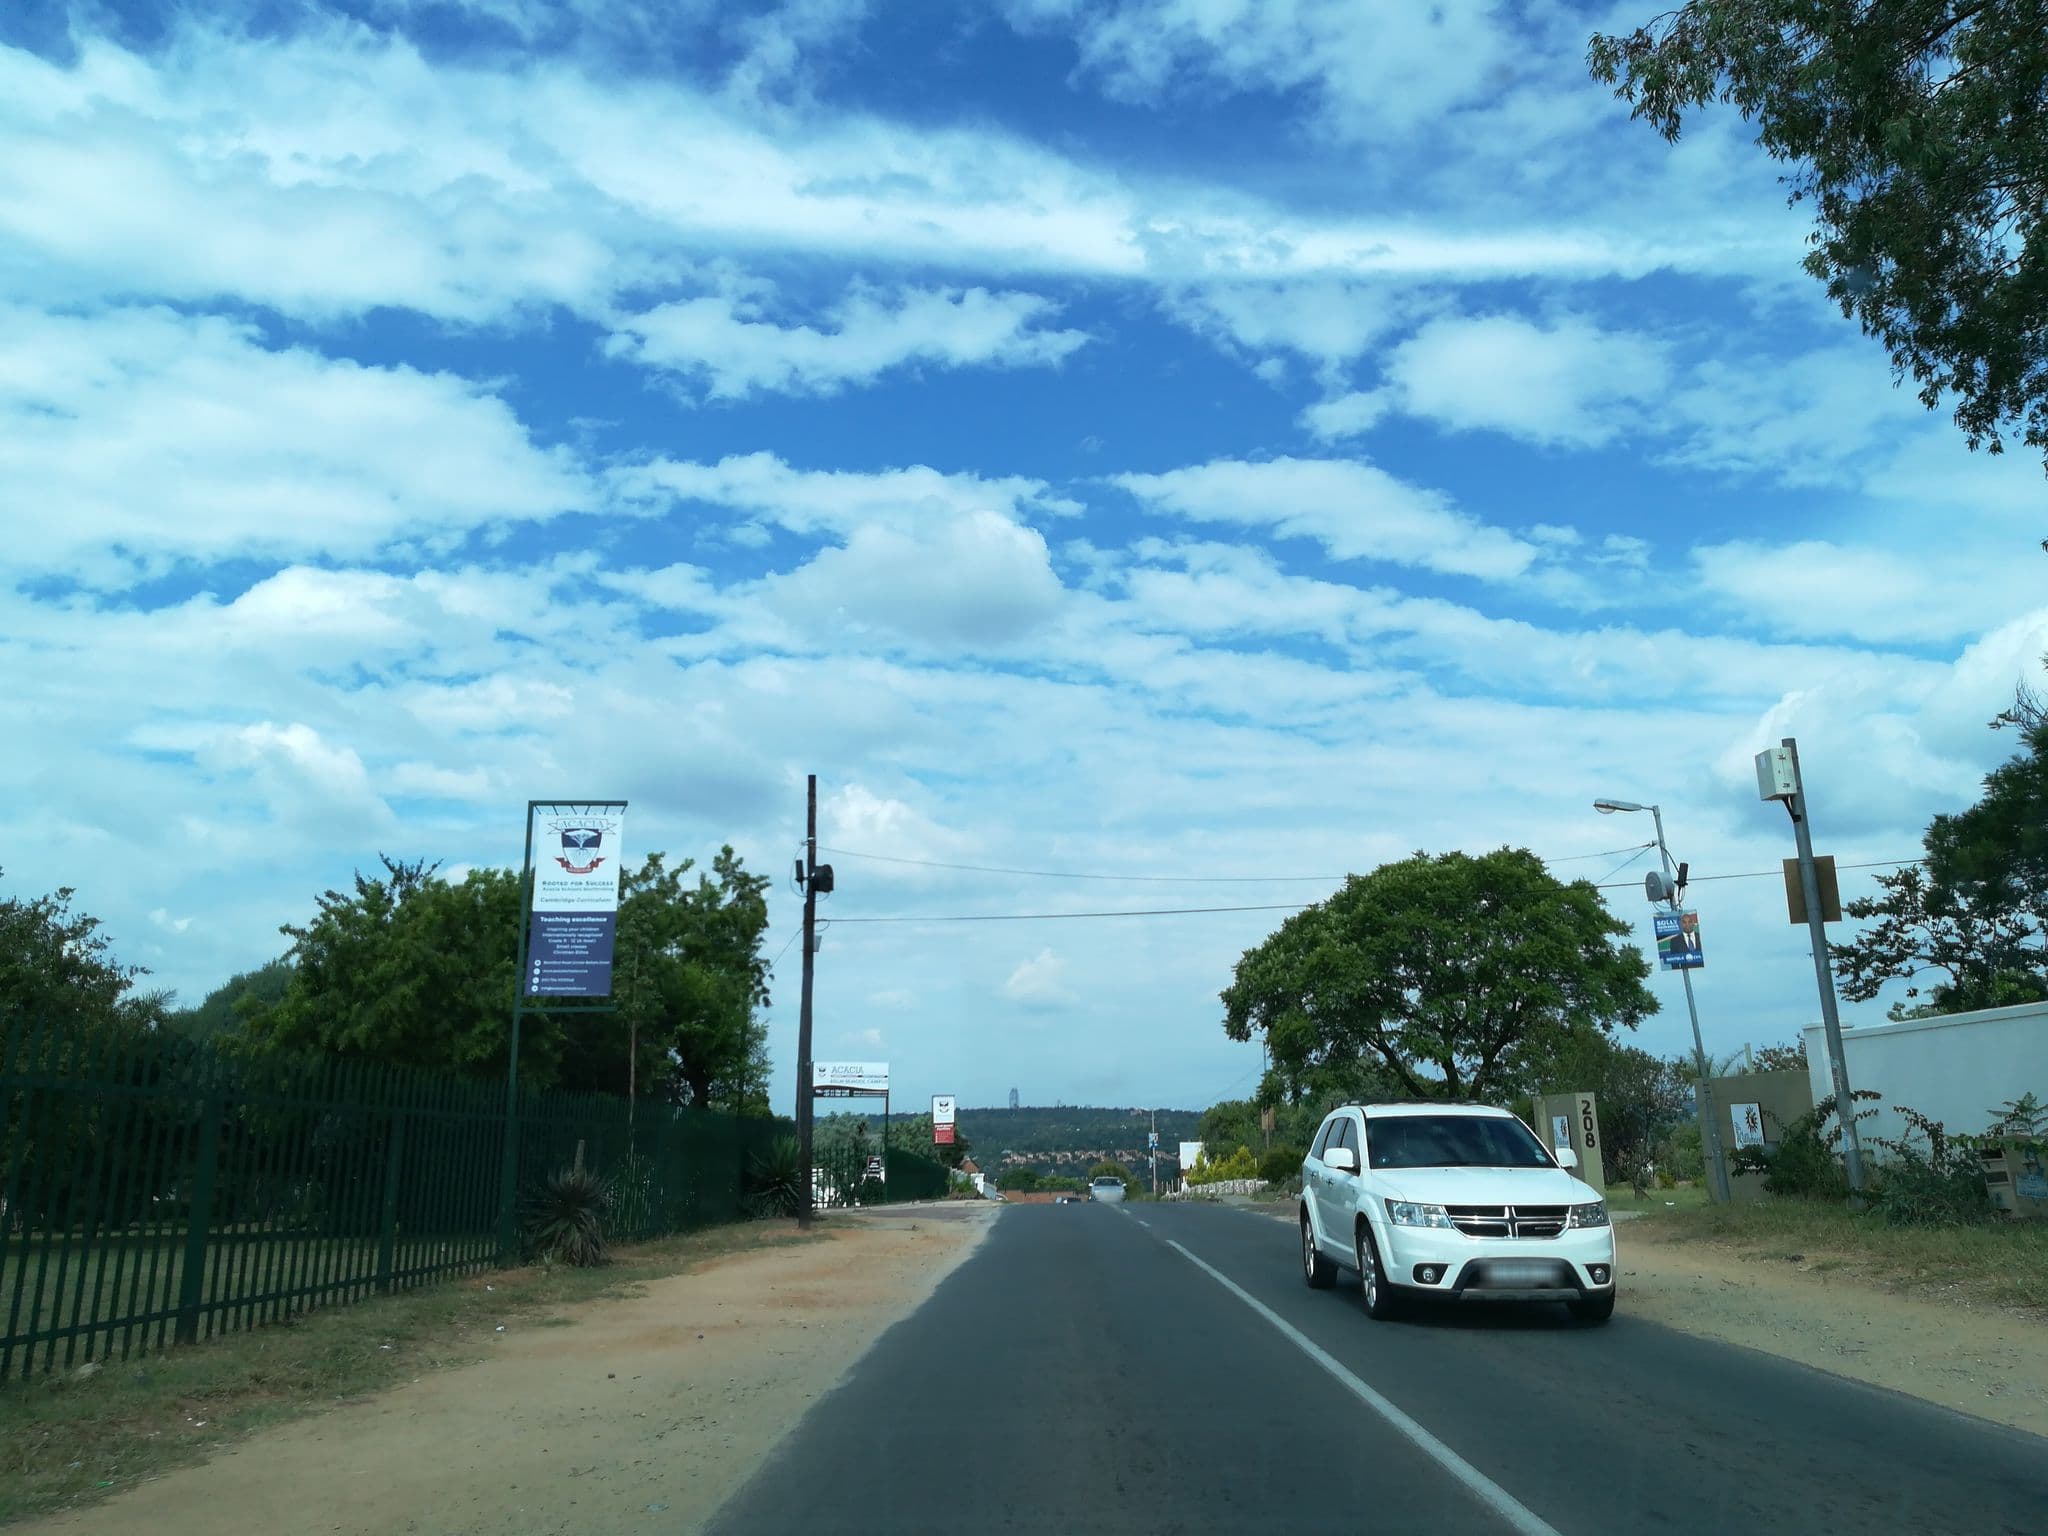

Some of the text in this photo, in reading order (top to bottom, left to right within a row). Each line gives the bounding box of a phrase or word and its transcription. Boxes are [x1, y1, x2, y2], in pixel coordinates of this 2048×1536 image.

[560, 820, 606, 829] ACACIA
[831, 1066, 865, 1074] ACACIA
[1581, 1099, 1596, 1149] 208
